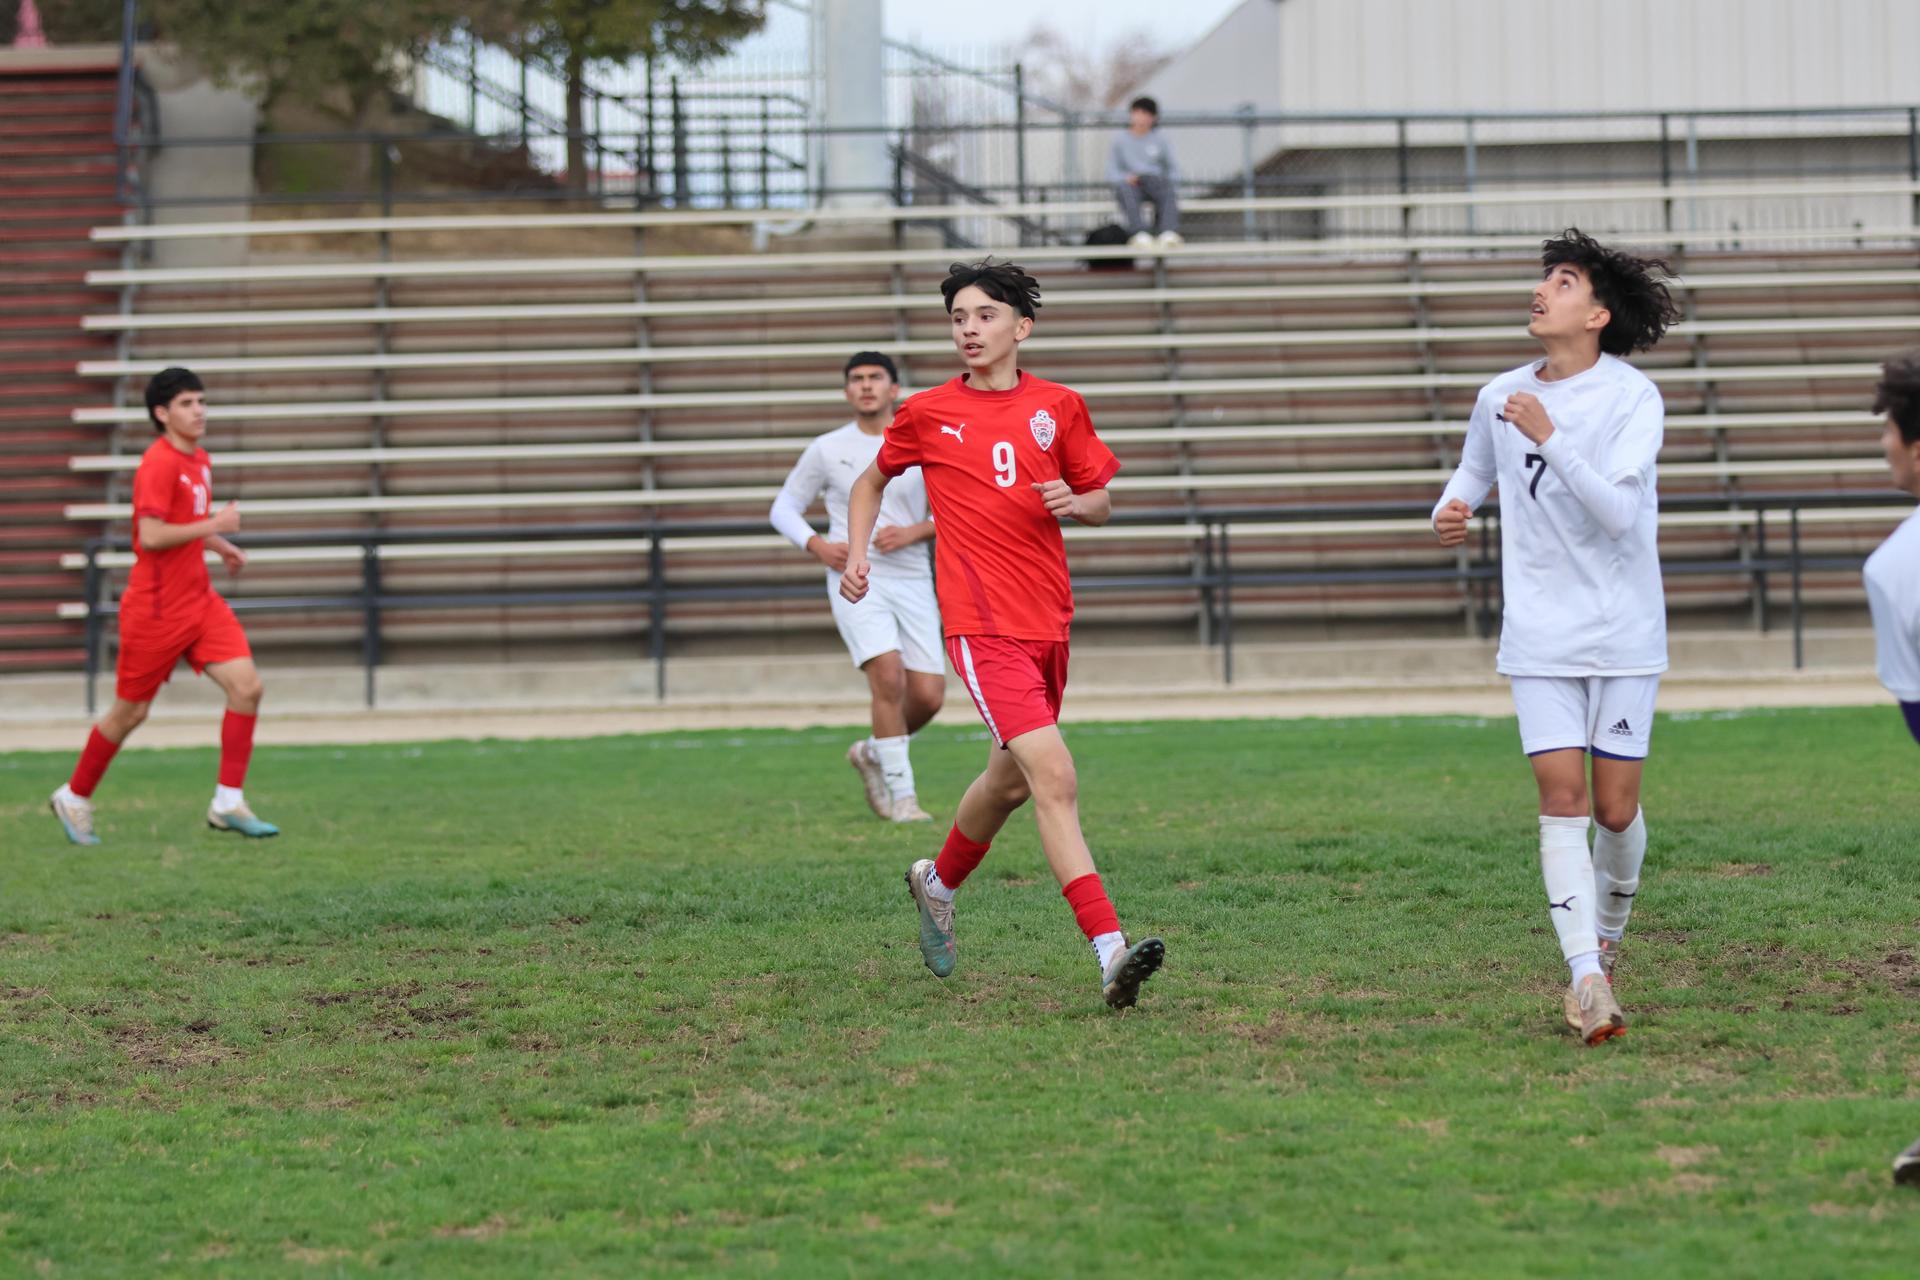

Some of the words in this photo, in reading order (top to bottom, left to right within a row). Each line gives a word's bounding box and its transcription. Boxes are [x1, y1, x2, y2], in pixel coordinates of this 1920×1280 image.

[992, 441, 1017, 488] 9
[1525, 453, 1547, 500] 7
[1608, 728, 1632, 736] adidas
